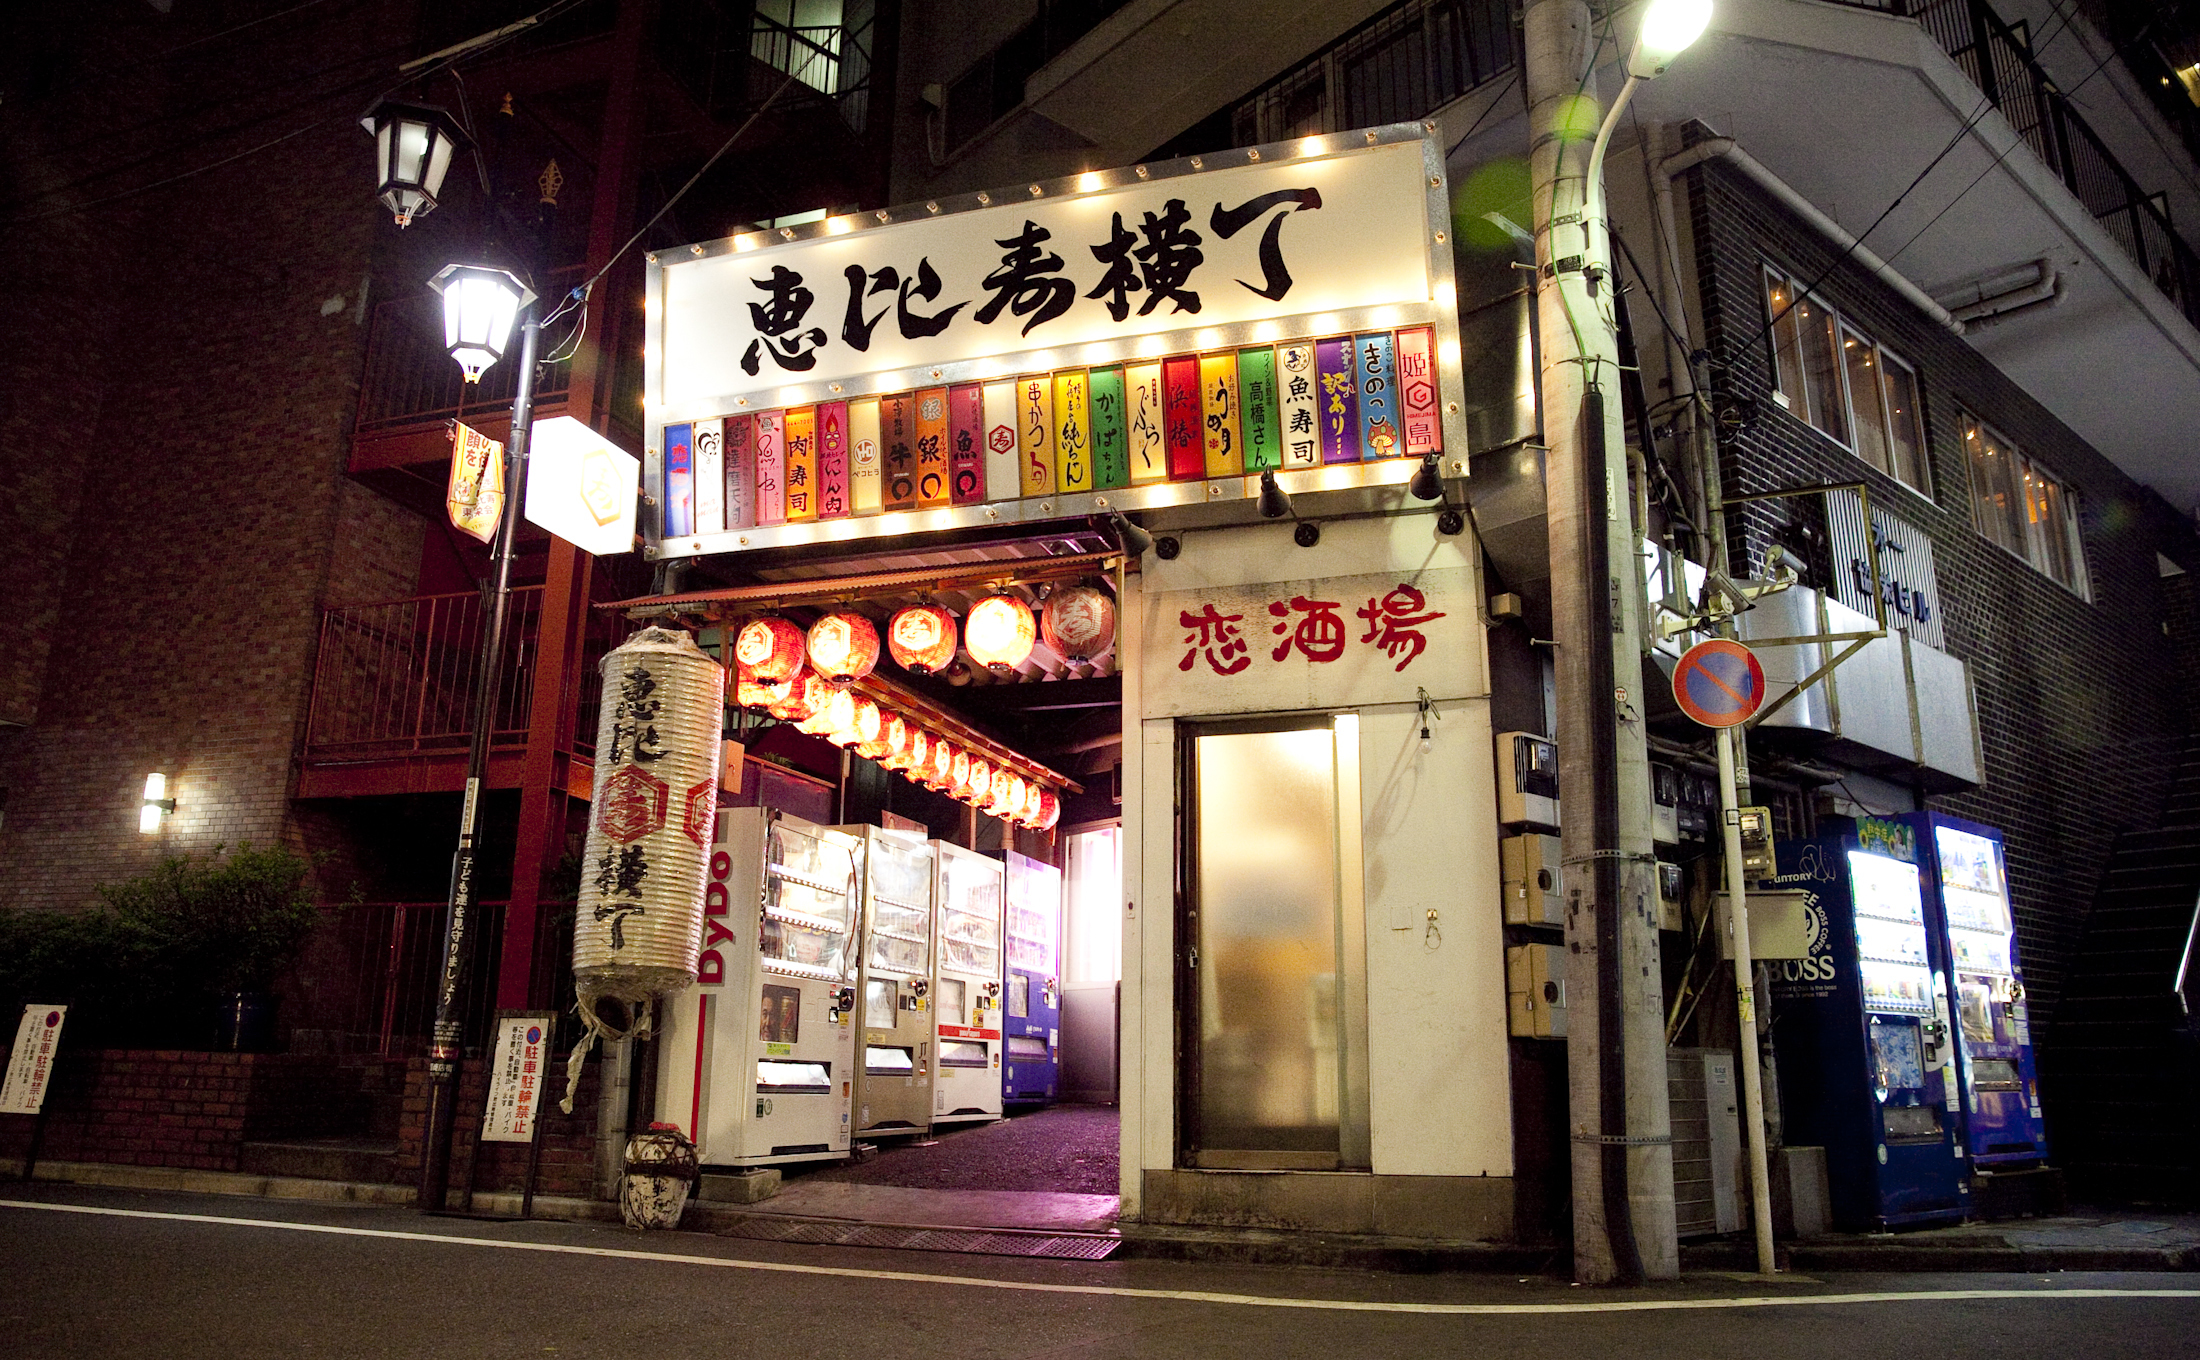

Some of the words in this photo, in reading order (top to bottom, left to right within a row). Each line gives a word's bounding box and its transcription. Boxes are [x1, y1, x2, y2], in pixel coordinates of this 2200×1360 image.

[740, 187, 1322, 376] 恵比寿横丁
[1028, 381, 1044, 447] 串かつ
[1286, 375, 1315, 463] 魚寿司
[1363, 342, 1386, 427] きのこ
[788, 435, 808, 512] 肉寿司
[1179, 583, 1446, 676] 恋酒場
[1811, 927, 1829, 955] COFFEE
[1815, 906, 1829, 926] BOSS
[1768, 955, 1836, 982] BOSS
[25, 1029, 54, 1108] 駐車駐輪禁止
[512, 1045, 539, 1133] 駐車駐輪禁止
